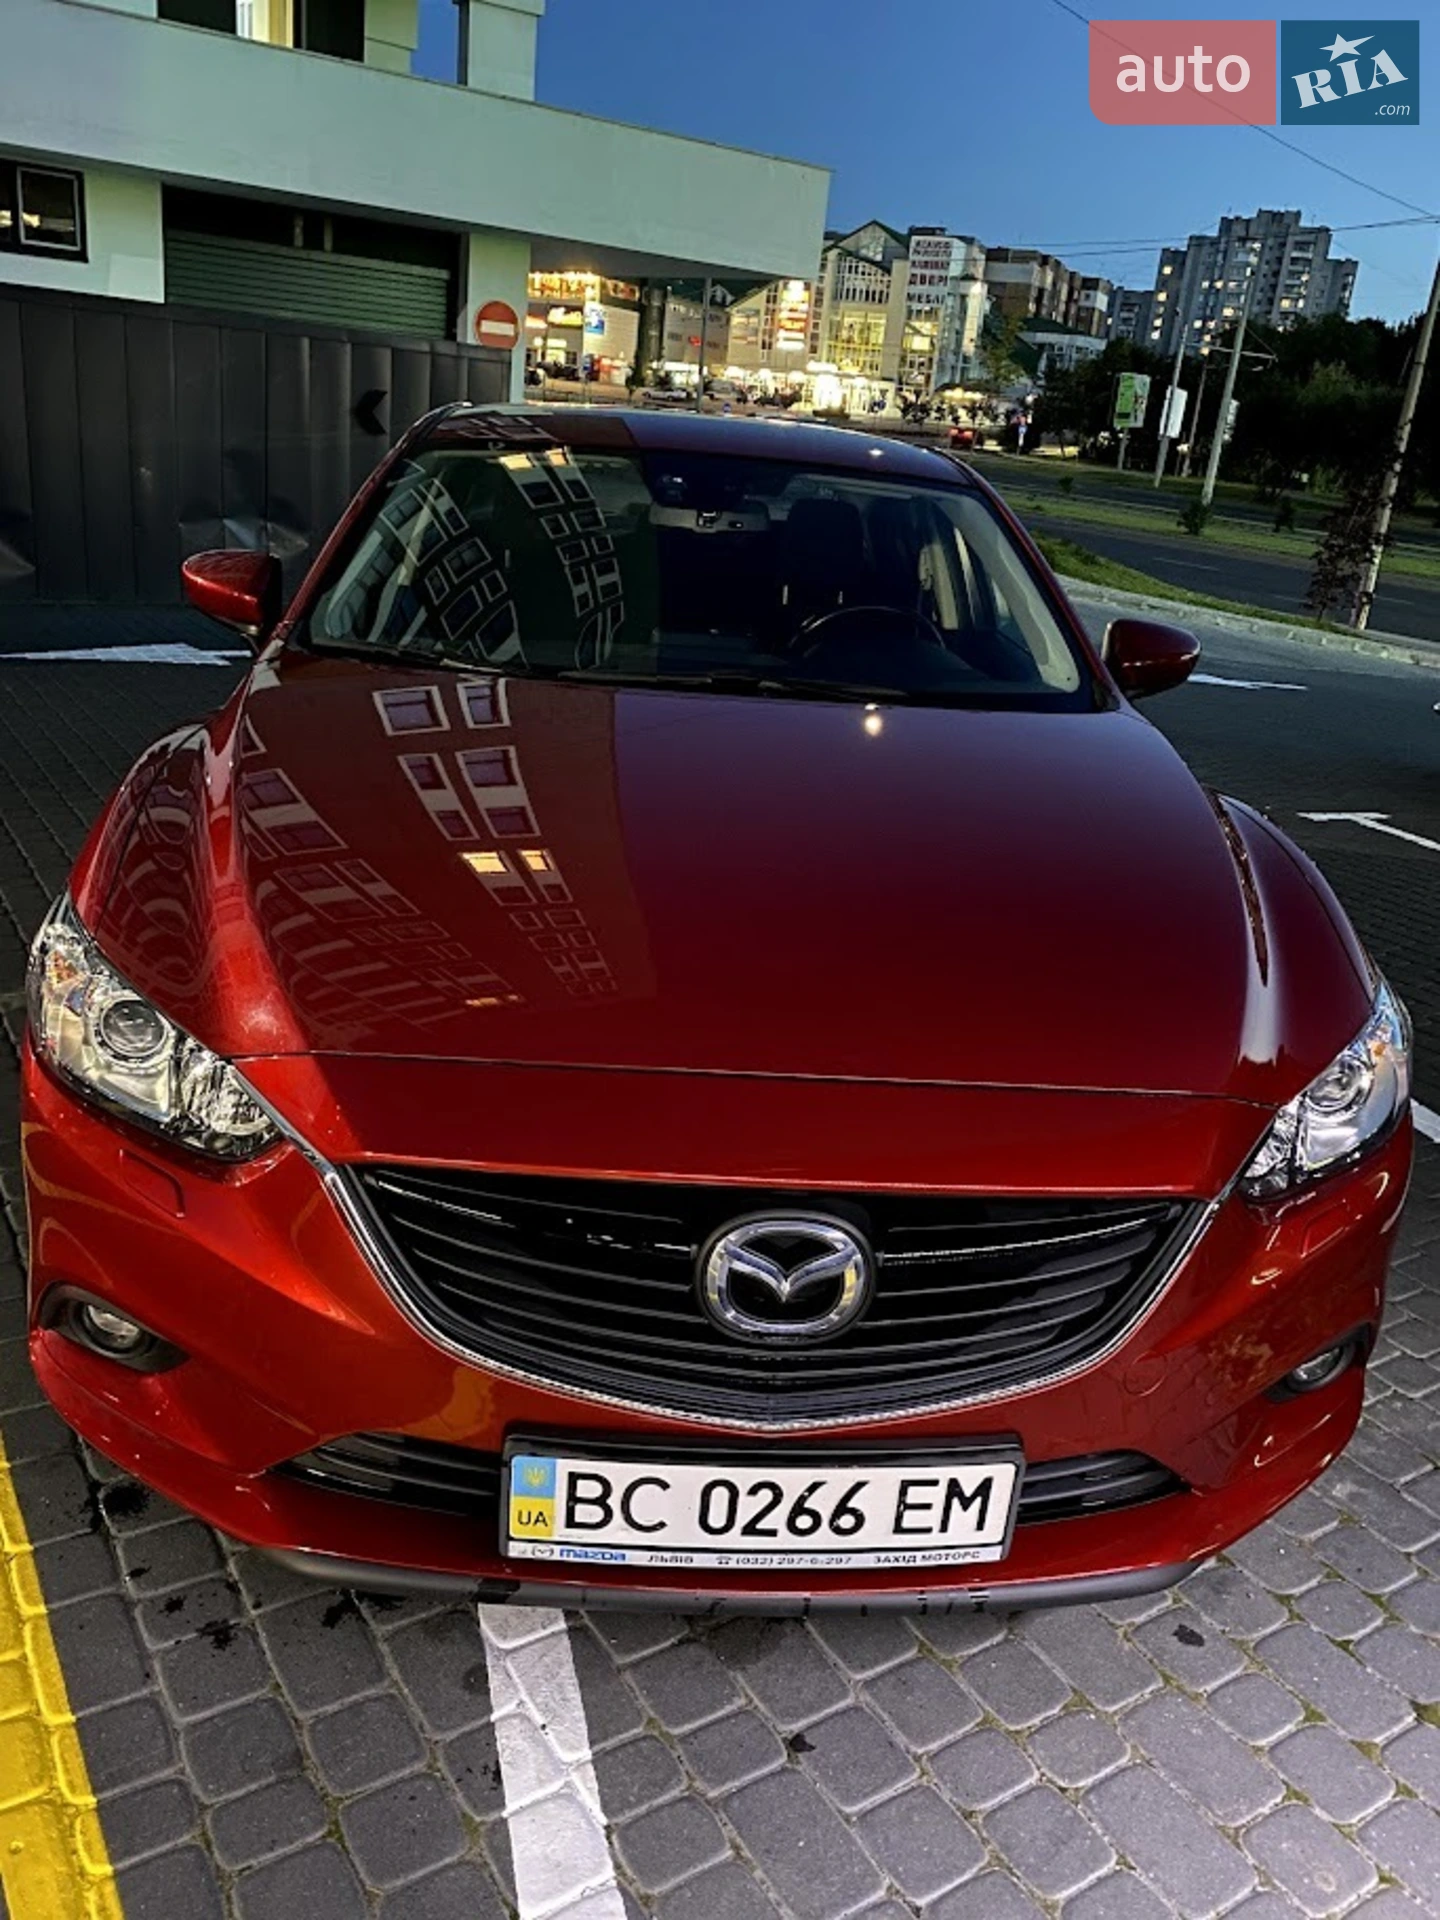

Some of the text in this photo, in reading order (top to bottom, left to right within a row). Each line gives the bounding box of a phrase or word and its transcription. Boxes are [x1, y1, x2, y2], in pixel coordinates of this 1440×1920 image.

[517, 1510, 548, 1527] UA
[564, 1470, 993, 1537] BC 0266 EM
